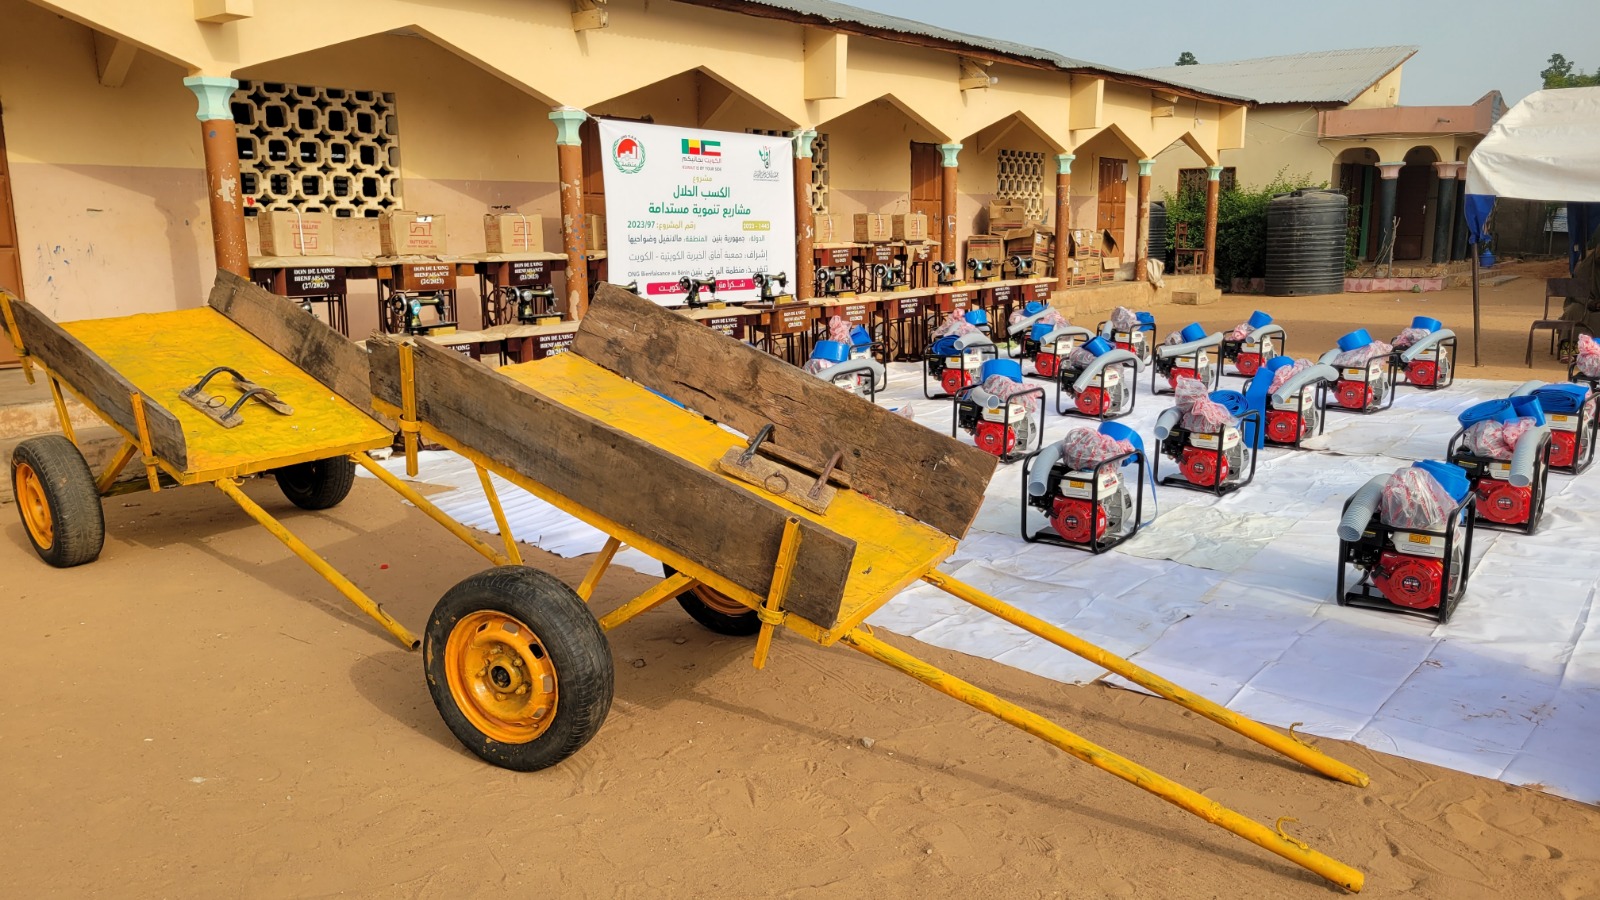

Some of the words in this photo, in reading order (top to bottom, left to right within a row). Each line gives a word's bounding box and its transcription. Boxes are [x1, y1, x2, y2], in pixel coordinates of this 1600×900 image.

[693, 175, 712, 183] مشروع
[673, 185, 698, 199] الحلال
[701, 187, 730, 200] الكسب
[648, 202, 689, 214] مستدامة
[693, 204, 720, 217] تنموية
[723, 204, 751, 218] مشاريع
[627, 221, 655, 229] 2023/97
[656, 221, 683, 230] المشروع:
[685, 221, 696, 230] رقم
[628, 235, 656, 245] وضواحيها
[712, 235, 722, 243] بنين
[724, 235, 745, 243] جمهورية
[629, 251, 653, 262] الكويت
[687, 250, 707, 261] الخيرية
[724, 250, 742, 260] جمعية
[690, 267, 702, 277] بنين
[704, 267, 714, 277] في
[716, 266, 724, 276] البر
[726, 266, 744, 274] منظمة
